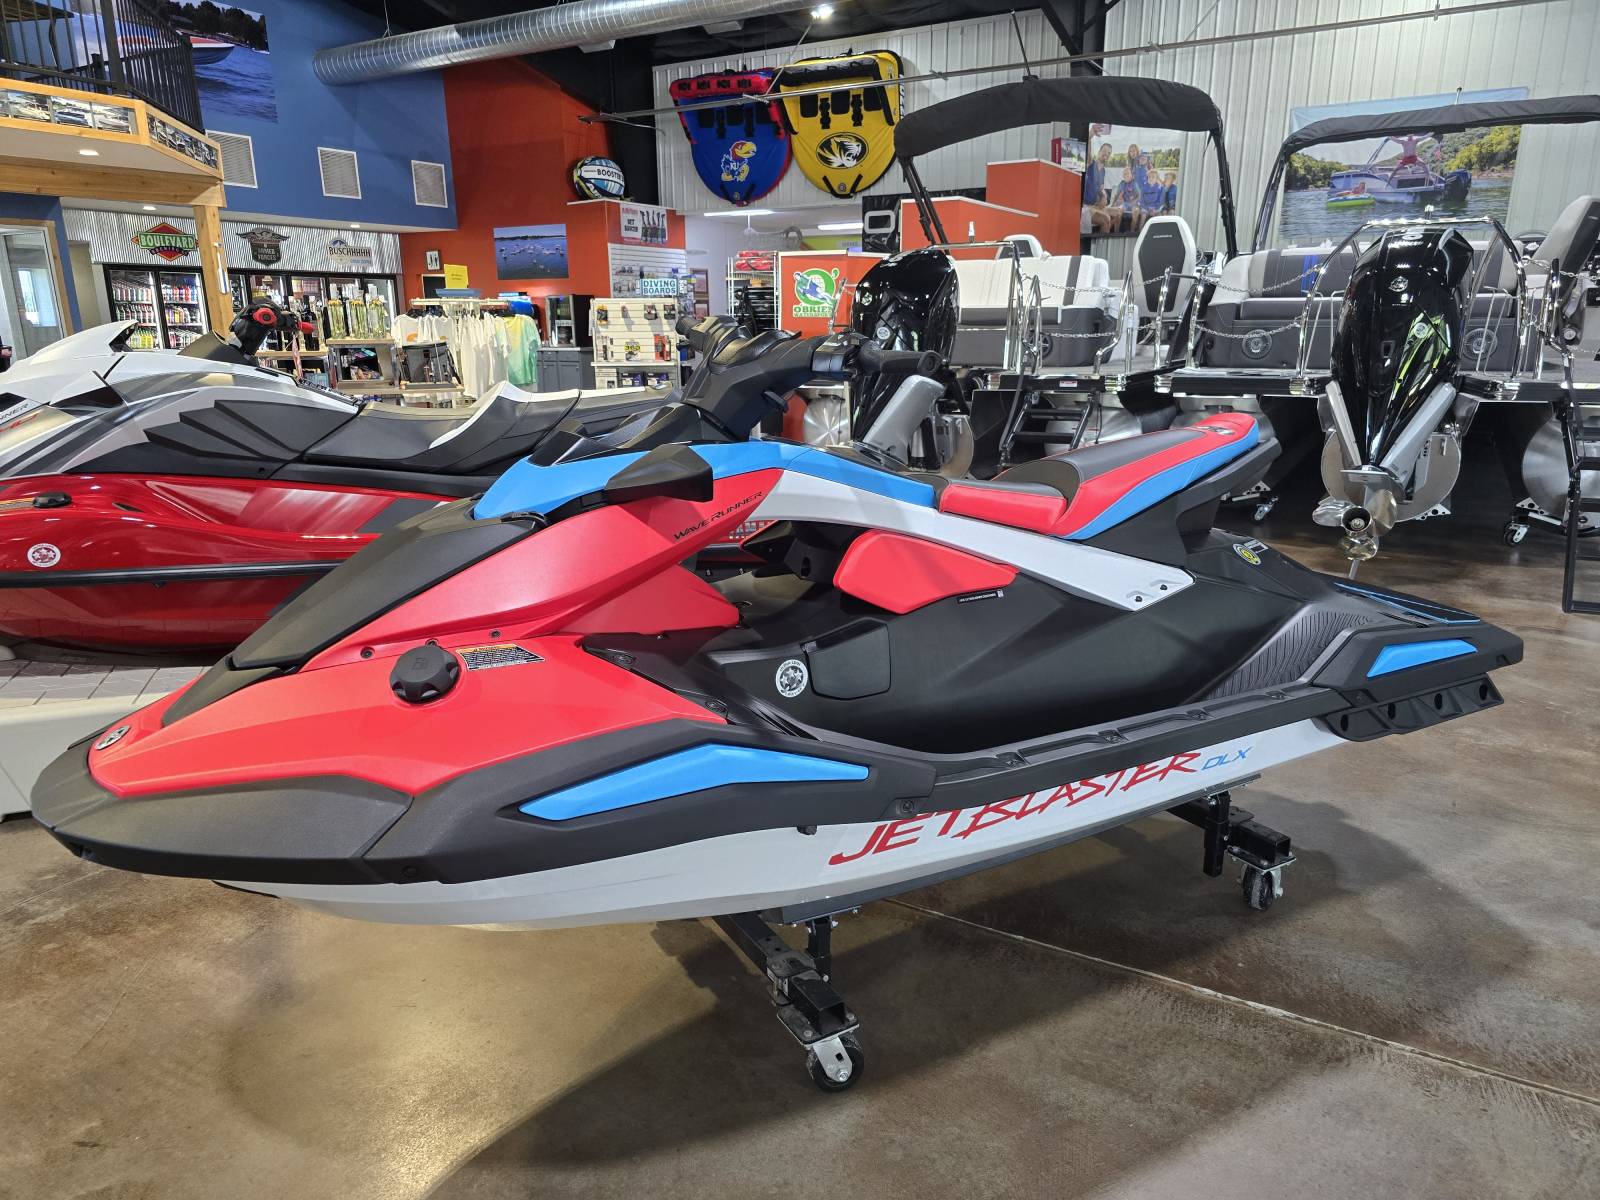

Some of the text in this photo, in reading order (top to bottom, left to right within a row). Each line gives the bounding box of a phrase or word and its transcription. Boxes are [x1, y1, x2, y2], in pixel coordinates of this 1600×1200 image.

[140, 234, 194, 249] BOULEVARD
[643, 280, 676, 288] DIVING
[1201, 746, 1253, 771] DLX
